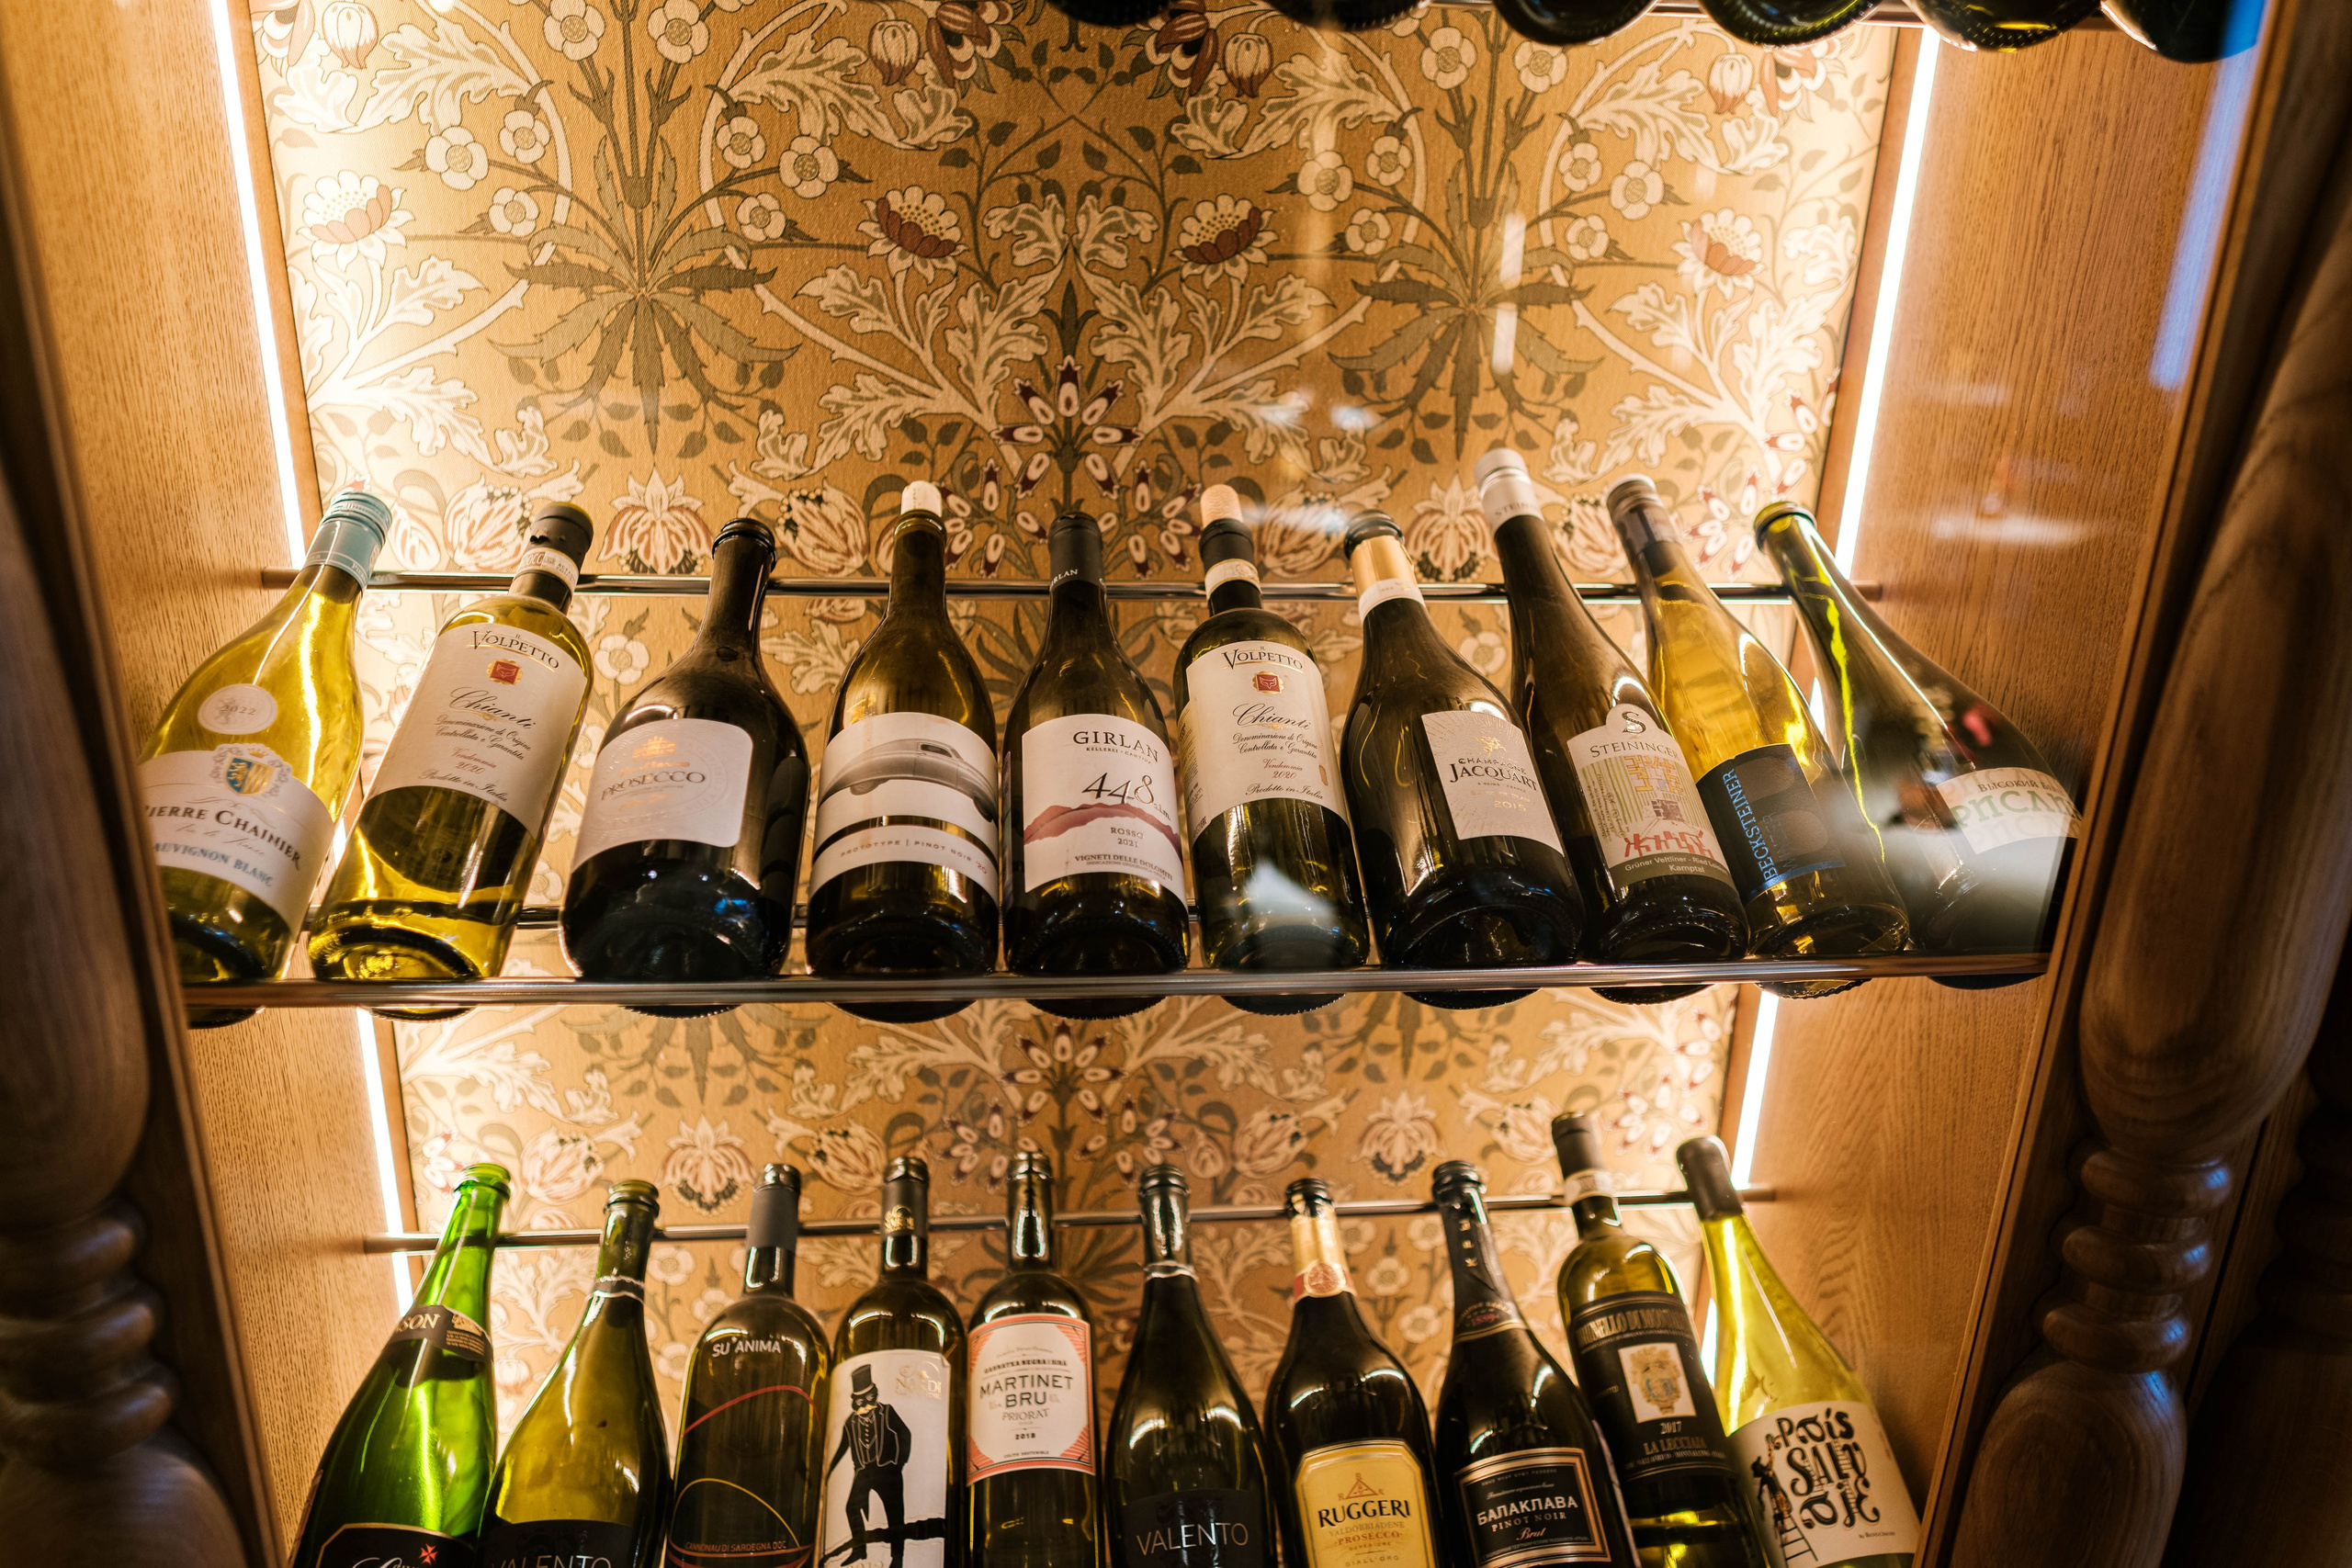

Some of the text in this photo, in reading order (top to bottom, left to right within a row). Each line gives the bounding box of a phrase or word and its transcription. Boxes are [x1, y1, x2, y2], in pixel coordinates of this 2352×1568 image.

[472, 631, 560, 669] VOLPETTO
[1222, 649, 1303, 670] VOLPETTO
[219, 705, 256, 715] 2022
[449, 687, 536, 729] Chianti
[1232, 703, 1311, 729] Chianti
[487, 735, 525, 761] Garantita
[506, 730, 531, 750] Origine
[1073, 731, 1159, 762] GIRLAN
[1233, 732, 1286, 744] Denominazione
[1238, 739, 1277, 754] Controllata
[1285, 741, 1317, 759] Garantita
[1589, 741, 1681, 761] STEININGER
[455, 761, 486, 774] 2020
[1262, 758, 1303, 771] Vendemmia
[1458, 758, 1527, 774] CHAMPAGNE
[1272, 771, 1296, 779] 2020
[1450, 763, 1537, 792] JACQUART
[601, 771, 707, 801] PROSECCO
[1081, 773, 1155, 805] 448
[1245, 784, 1284, 795] Prodotto
[1296, 785, 1324, 799] Italia
[1977, 781, 2041, 793] ВЫСОКИЙ
[1494, 800, 1526, 811] 2015
[1111, 828, 1144, 840] ROSSO
[1722, 769, 1779, 881] BECKSTEINER
[145, 806, 302, 871] IERRE CHAINIER
[1117, 838, 1138, 848] 2021
[841, 840, 900, 857] PROTOTYPE
[914, 840, 945, 852] PINOT
[950, 849, 972, 862] NOIR
[153, 842, 275, 886] AUVIGNON BLANC
[1114, 854, 1137, 863] DELLE
[1139, 860, 1173, 881] DOLOMITI
[1625, 860, 1653, 871] Grüner
[1669, 864, 1705, 873] Kamptal
[979, 1374, 1073, 1398] MARTINET
[1006, 1392, 1047, 1407] BRU
[1001, 1408, 1049, 1421] PRIORAT
[1660, 1421, 1682, 1434] 2017
[1318, 1499, 1410, 1528] RUGGERI
[1476, 1495, 1578, 1525] БАЛАКЛАВА
[1329, 1521, 1405, 1537] VALDOBBIADENE
[1491, 1512, 1566, 1532] PINOT NOIR
[1136, 1523, 1249, 1555] VALENTO
[1516, 1527, 1546, 1540] Brut
[685, 1540, 786, 1552] CANNONAU DI SARDEGNA DOC
